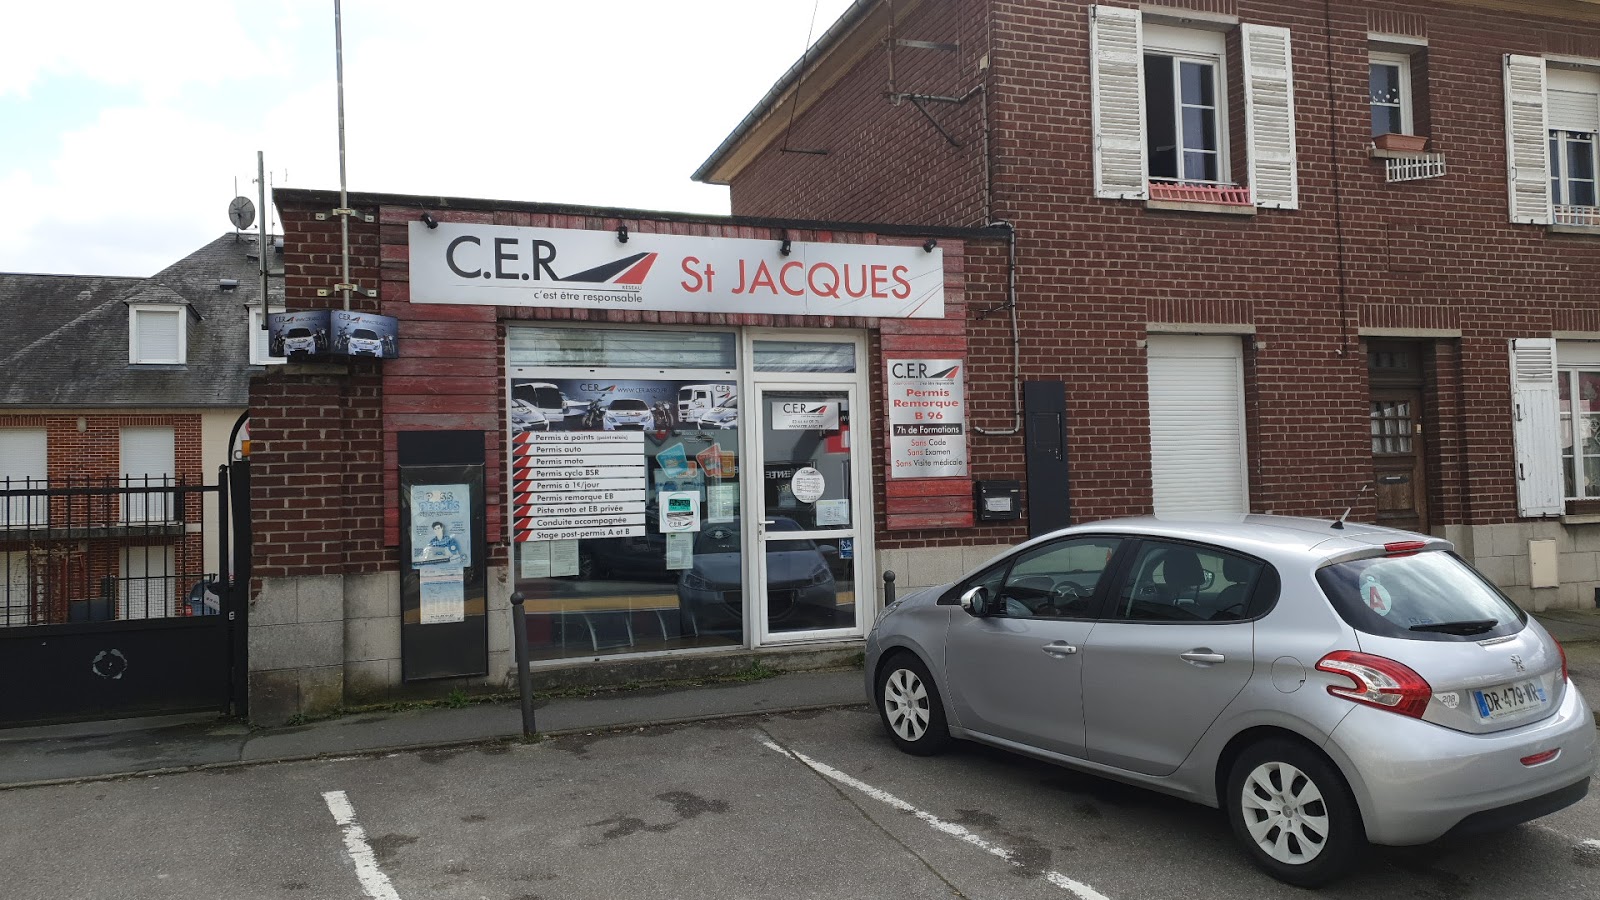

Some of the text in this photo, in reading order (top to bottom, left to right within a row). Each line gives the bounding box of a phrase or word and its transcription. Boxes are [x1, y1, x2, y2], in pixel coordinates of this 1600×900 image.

[446, 236, 559, 281] C.E.R
[681, 256, 911, 300] St JACQUES
[533, 290, 642, 304] c'est être responsable
[892, 362, 928, 378] C.E.R
[906, 388, 950, 396] Permis
[894, 399, 958, 408] Remorque
[783, 403, 806, 414] C.E.R
[915, 411, 943, 420] B 96
[896, 425, 960, 434] 7h de Formations
[571, 434, 594, 442] points
[928, 438, 946, 446] Code
[908, 448, 950, 456] Sans Examen
[933, 458, 962, 466] médicale
[564, 470, 583, 478] cyclo
[572, 482, 600, 490] 1€/jour
[536, 492, 614, 502] Permis remorque EB
[536, 506, 554, 514] Piste
[600, 504, 623, 514] privée
[536, 517, 626, 526] Conduite accompagnée
[536, 531, 558, 540] Stage
[562, 529, 606, 538] post-permis
[608, 528, 614, 536] A
[1370, 586, 1386, 610] A
[1442, 694, 1456, 703] 208
